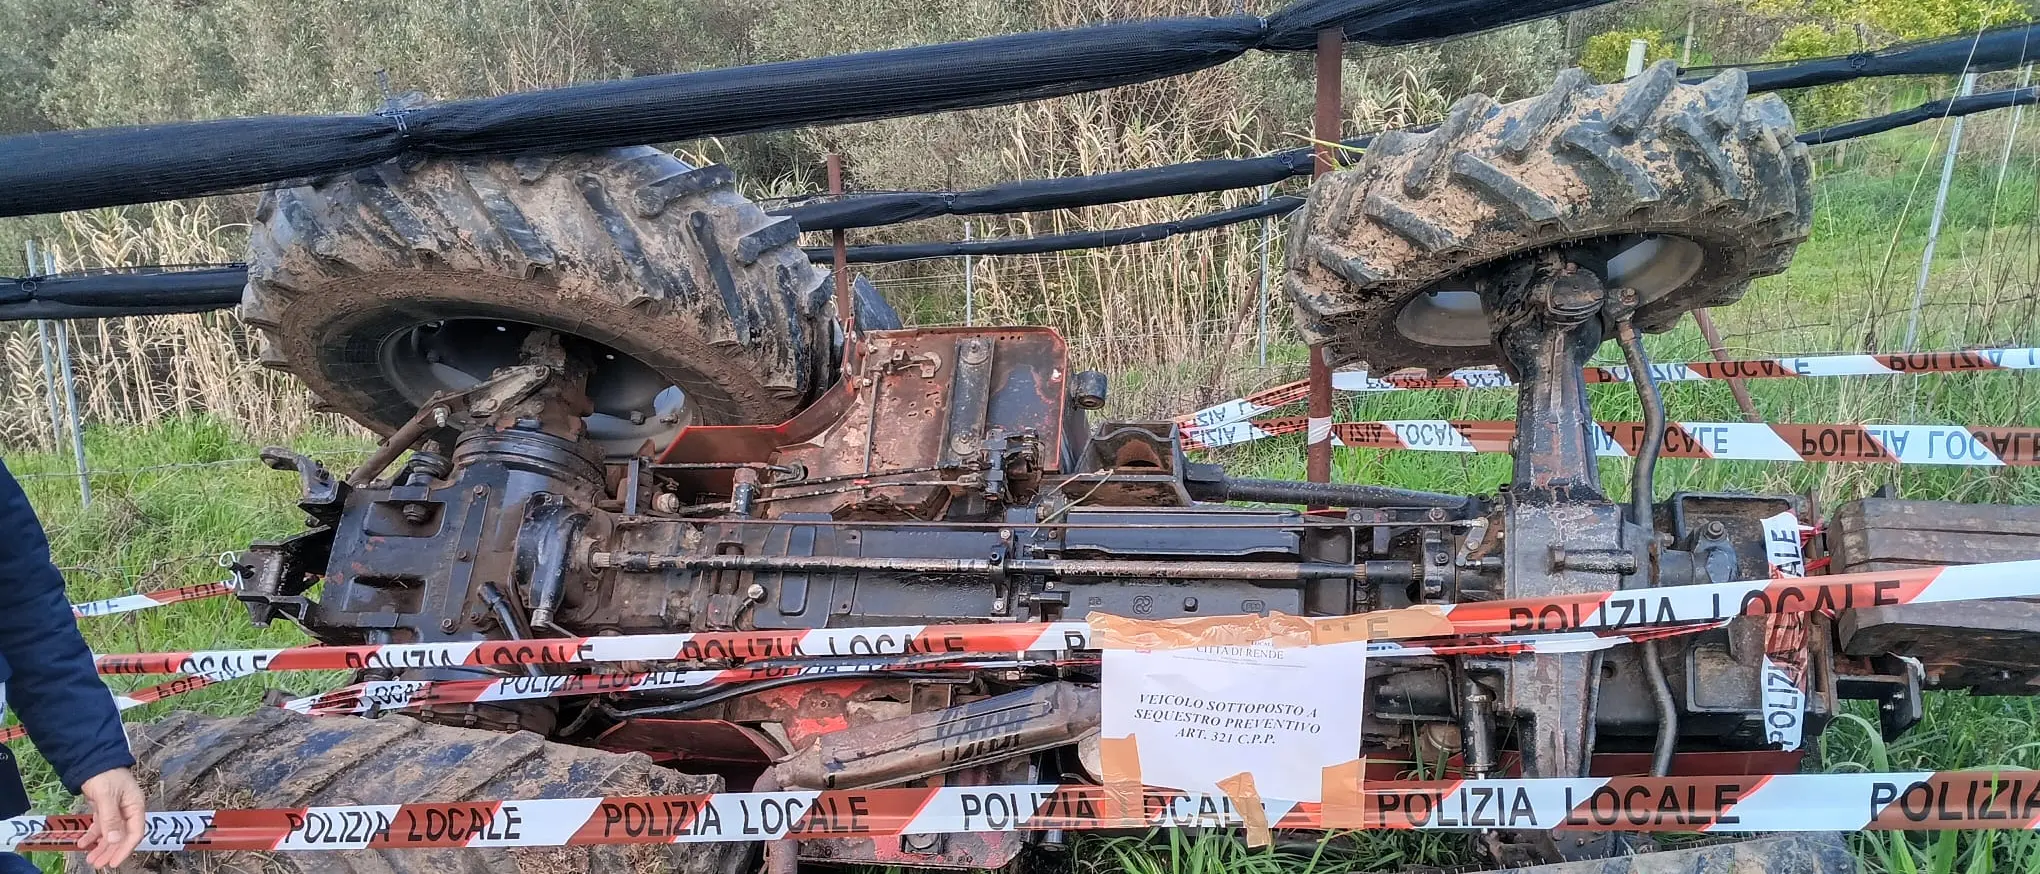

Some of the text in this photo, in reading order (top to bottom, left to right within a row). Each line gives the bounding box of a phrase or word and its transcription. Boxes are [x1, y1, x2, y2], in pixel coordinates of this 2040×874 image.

[1771, 529, 1801, 577] ALE
[1509, 580, 1900, 632] POLIZIA LOCALE
[682, 632, 965, 661] POLIZIA LOCALE
[1246, 648, 1284, 660] RENDE
[1134, 708, 1321, 734] SEQUESTRO PREVENTIVO
[1139, 694, 1318, 718] VEICOLO SOTTOPOSTO A
[1175, 727, 1276, 745] ART. 321 C.P.P.
[602, 796, 870, 837] POLIZIA LOCALE
[961, 791, 1264, 831] POLIZIA OCAL
[1377, 784, 1740, 828] POLIZIA LOCALE
[1870, 779, 2040, 822] POLIZIA
[284, 806, 522, 844] POLIZIA LOCALE
